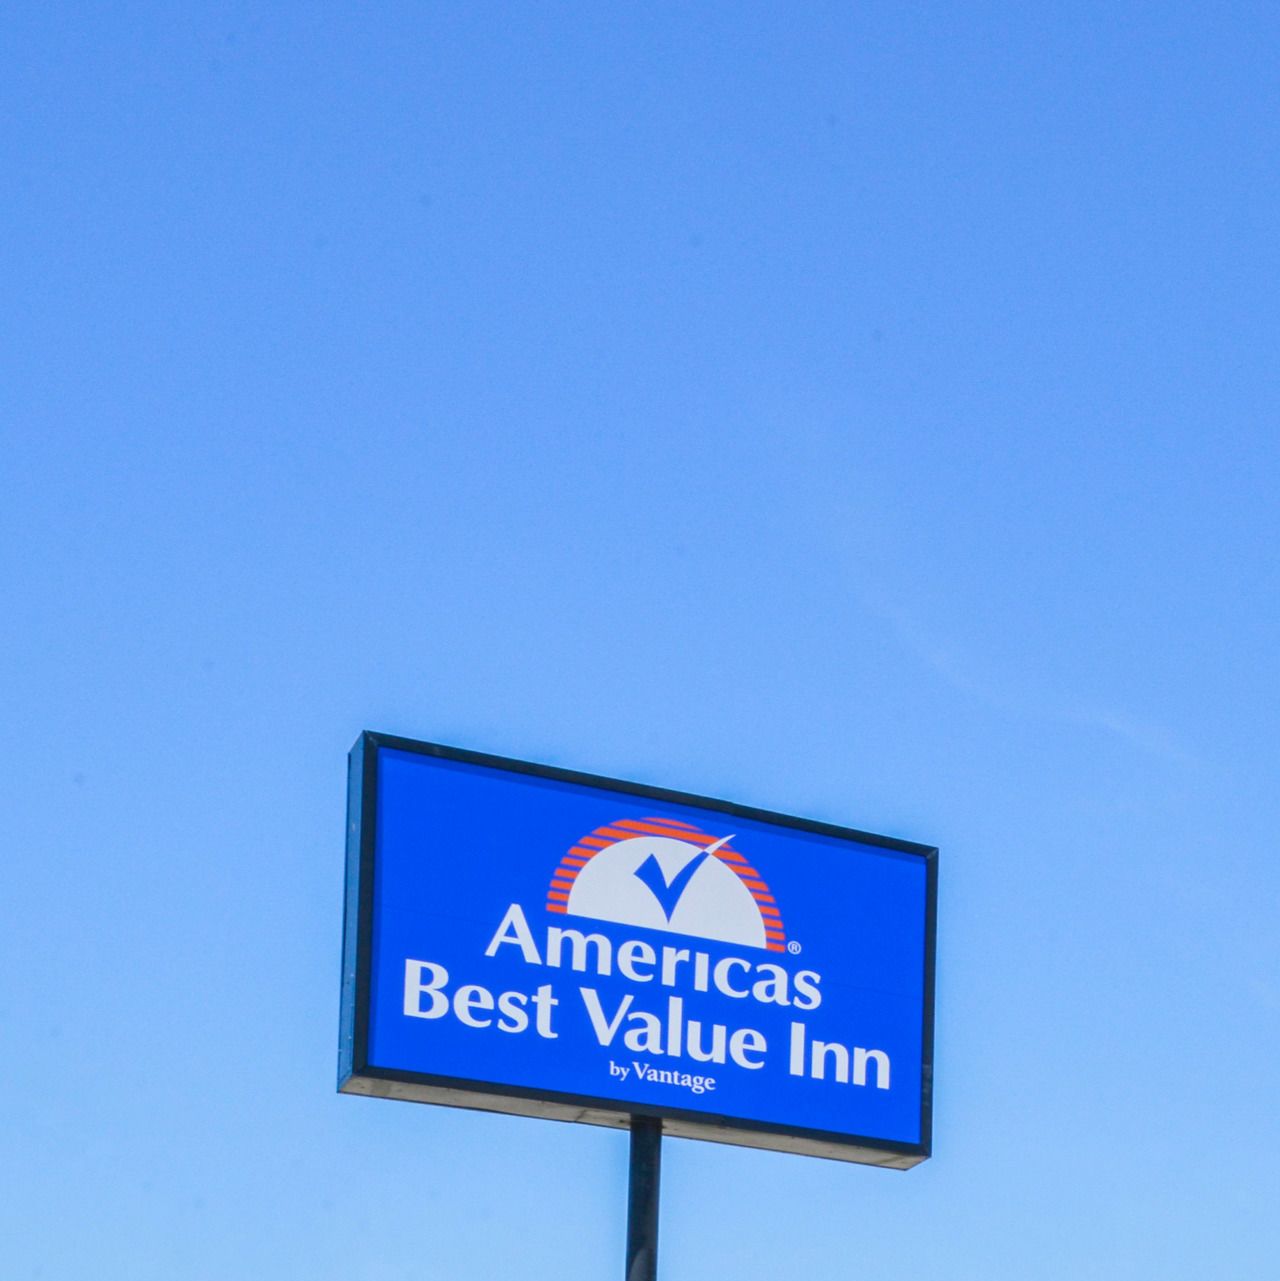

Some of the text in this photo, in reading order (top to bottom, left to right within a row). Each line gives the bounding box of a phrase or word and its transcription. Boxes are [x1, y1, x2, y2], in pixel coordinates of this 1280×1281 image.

[485, 903, 822, 1010] Americas
[402, 958, 891, 1090] Best Value Inn
[609, 1060, 716, 1094] by Vantage
